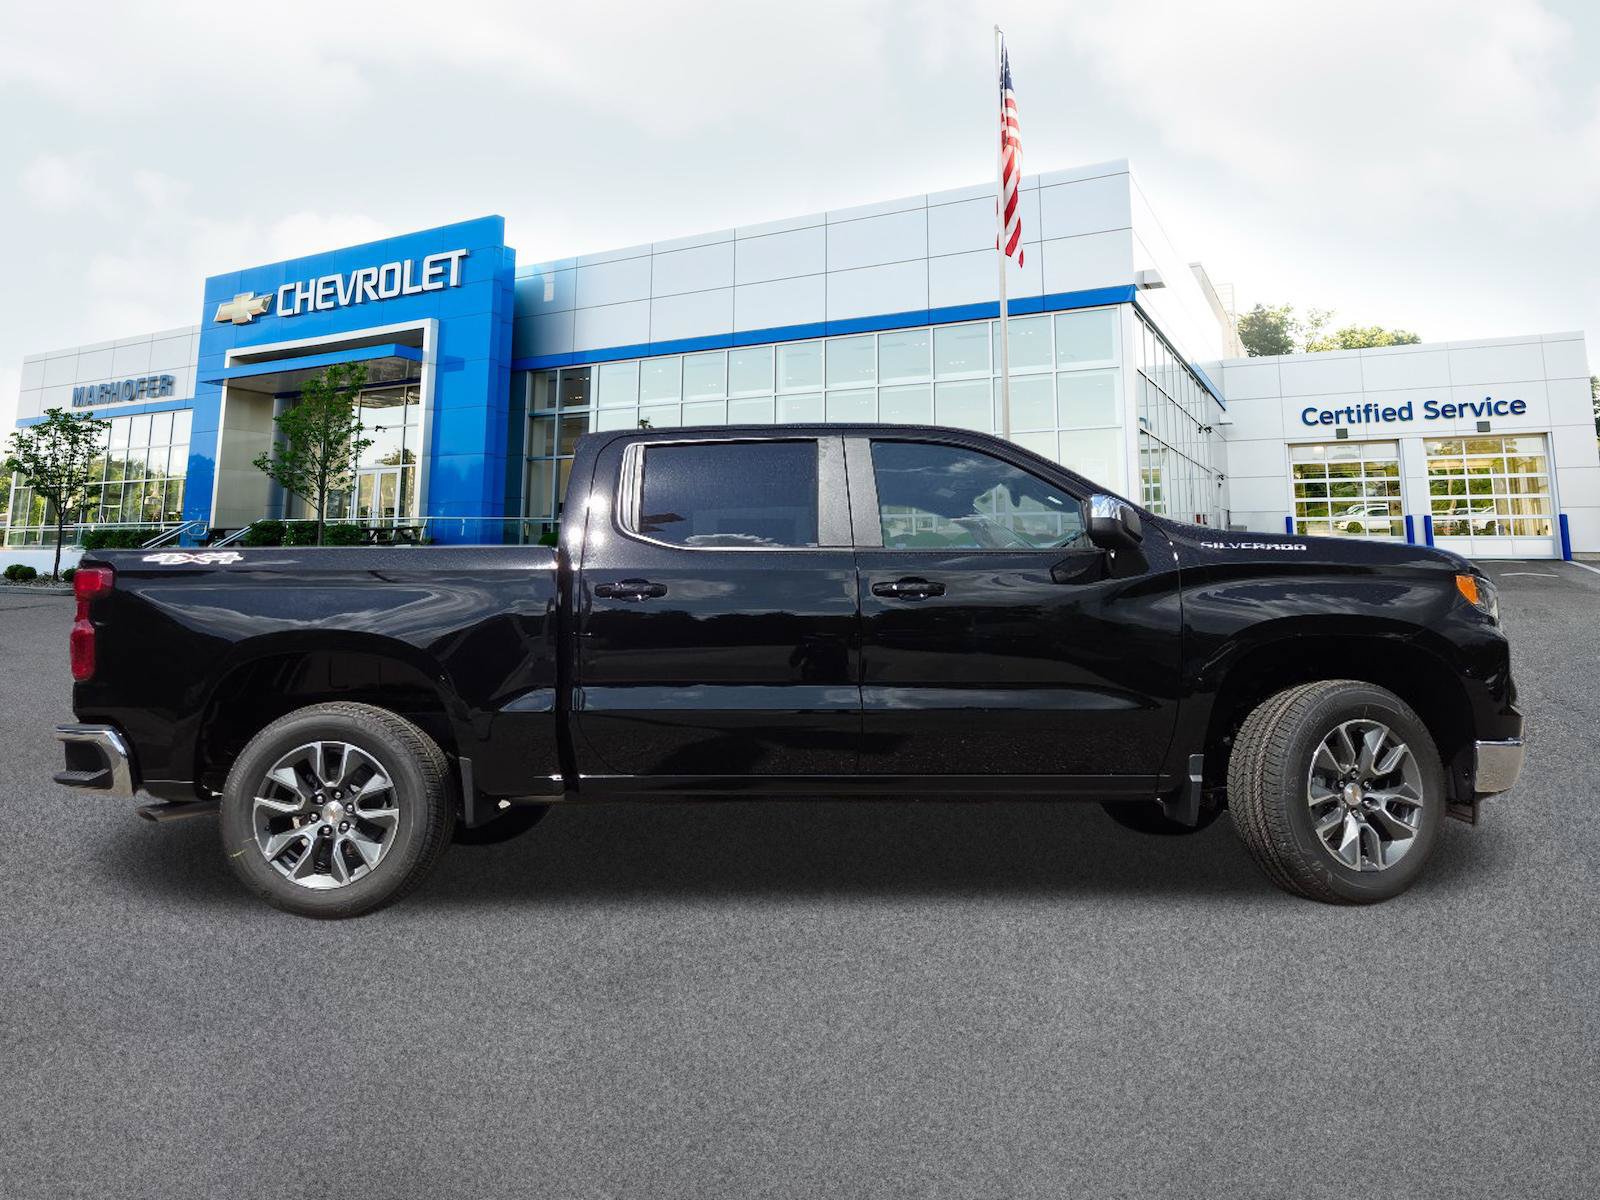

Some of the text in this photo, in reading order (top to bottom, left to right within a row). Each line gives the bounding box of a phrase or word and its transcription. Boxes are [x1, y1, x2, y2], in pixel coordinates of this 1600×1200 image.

[276, 248, 469, 317] CHEVROLET
[72, 374, 175, 407] MARHOFER
[1301, 396, 1527, 427] Certified Service
[1200, 541, 1307, 551] SILVERADO
